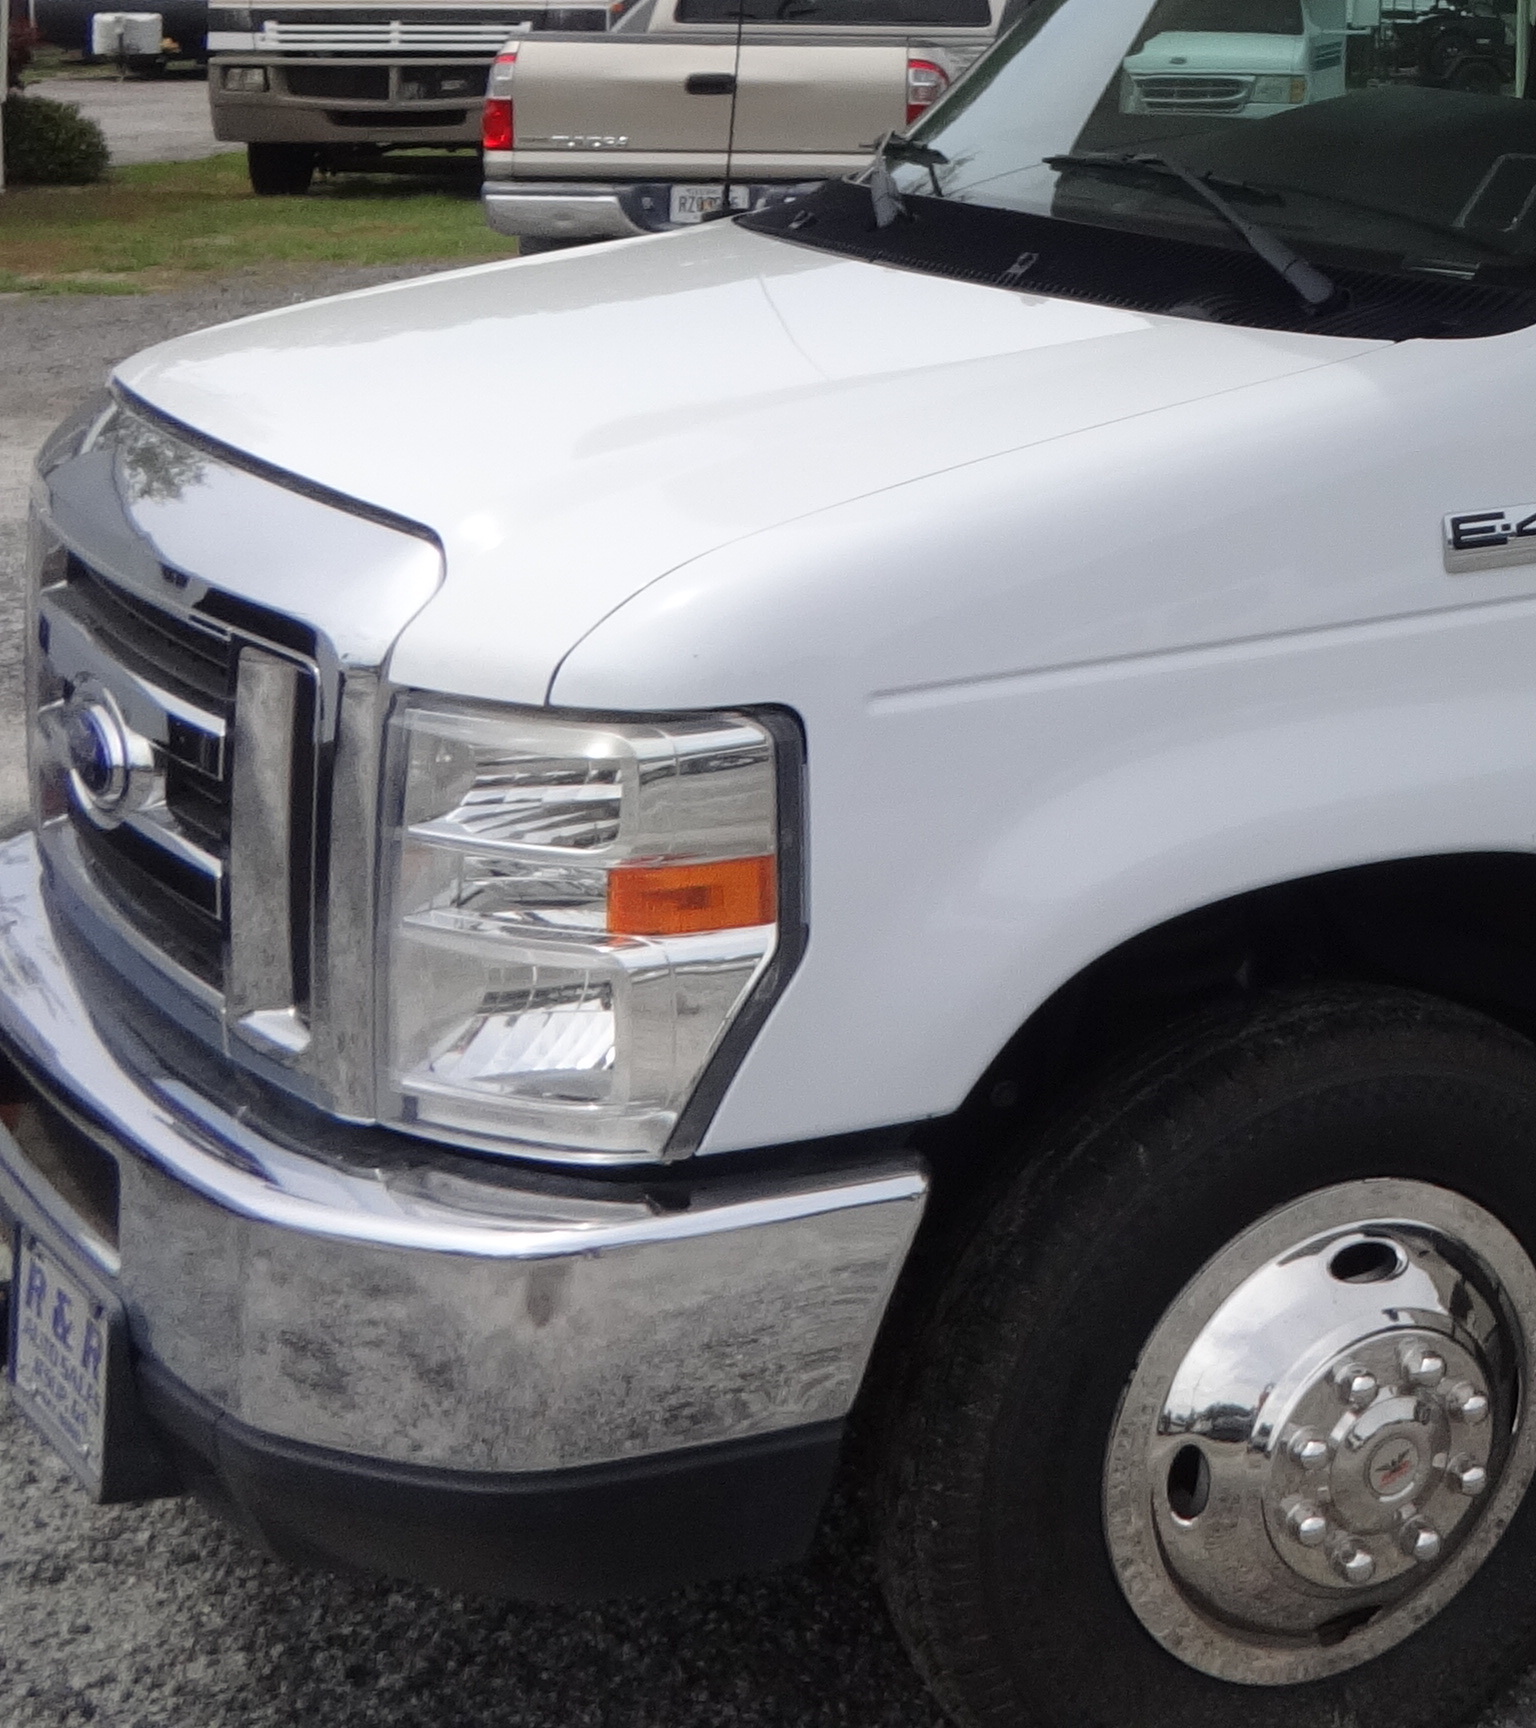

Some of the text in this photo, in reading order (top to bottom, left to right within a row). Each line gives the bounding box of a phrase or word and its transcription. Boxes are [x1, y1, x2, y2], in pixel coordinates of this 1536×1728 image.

[26, 1260, 102, 1379] R & R
